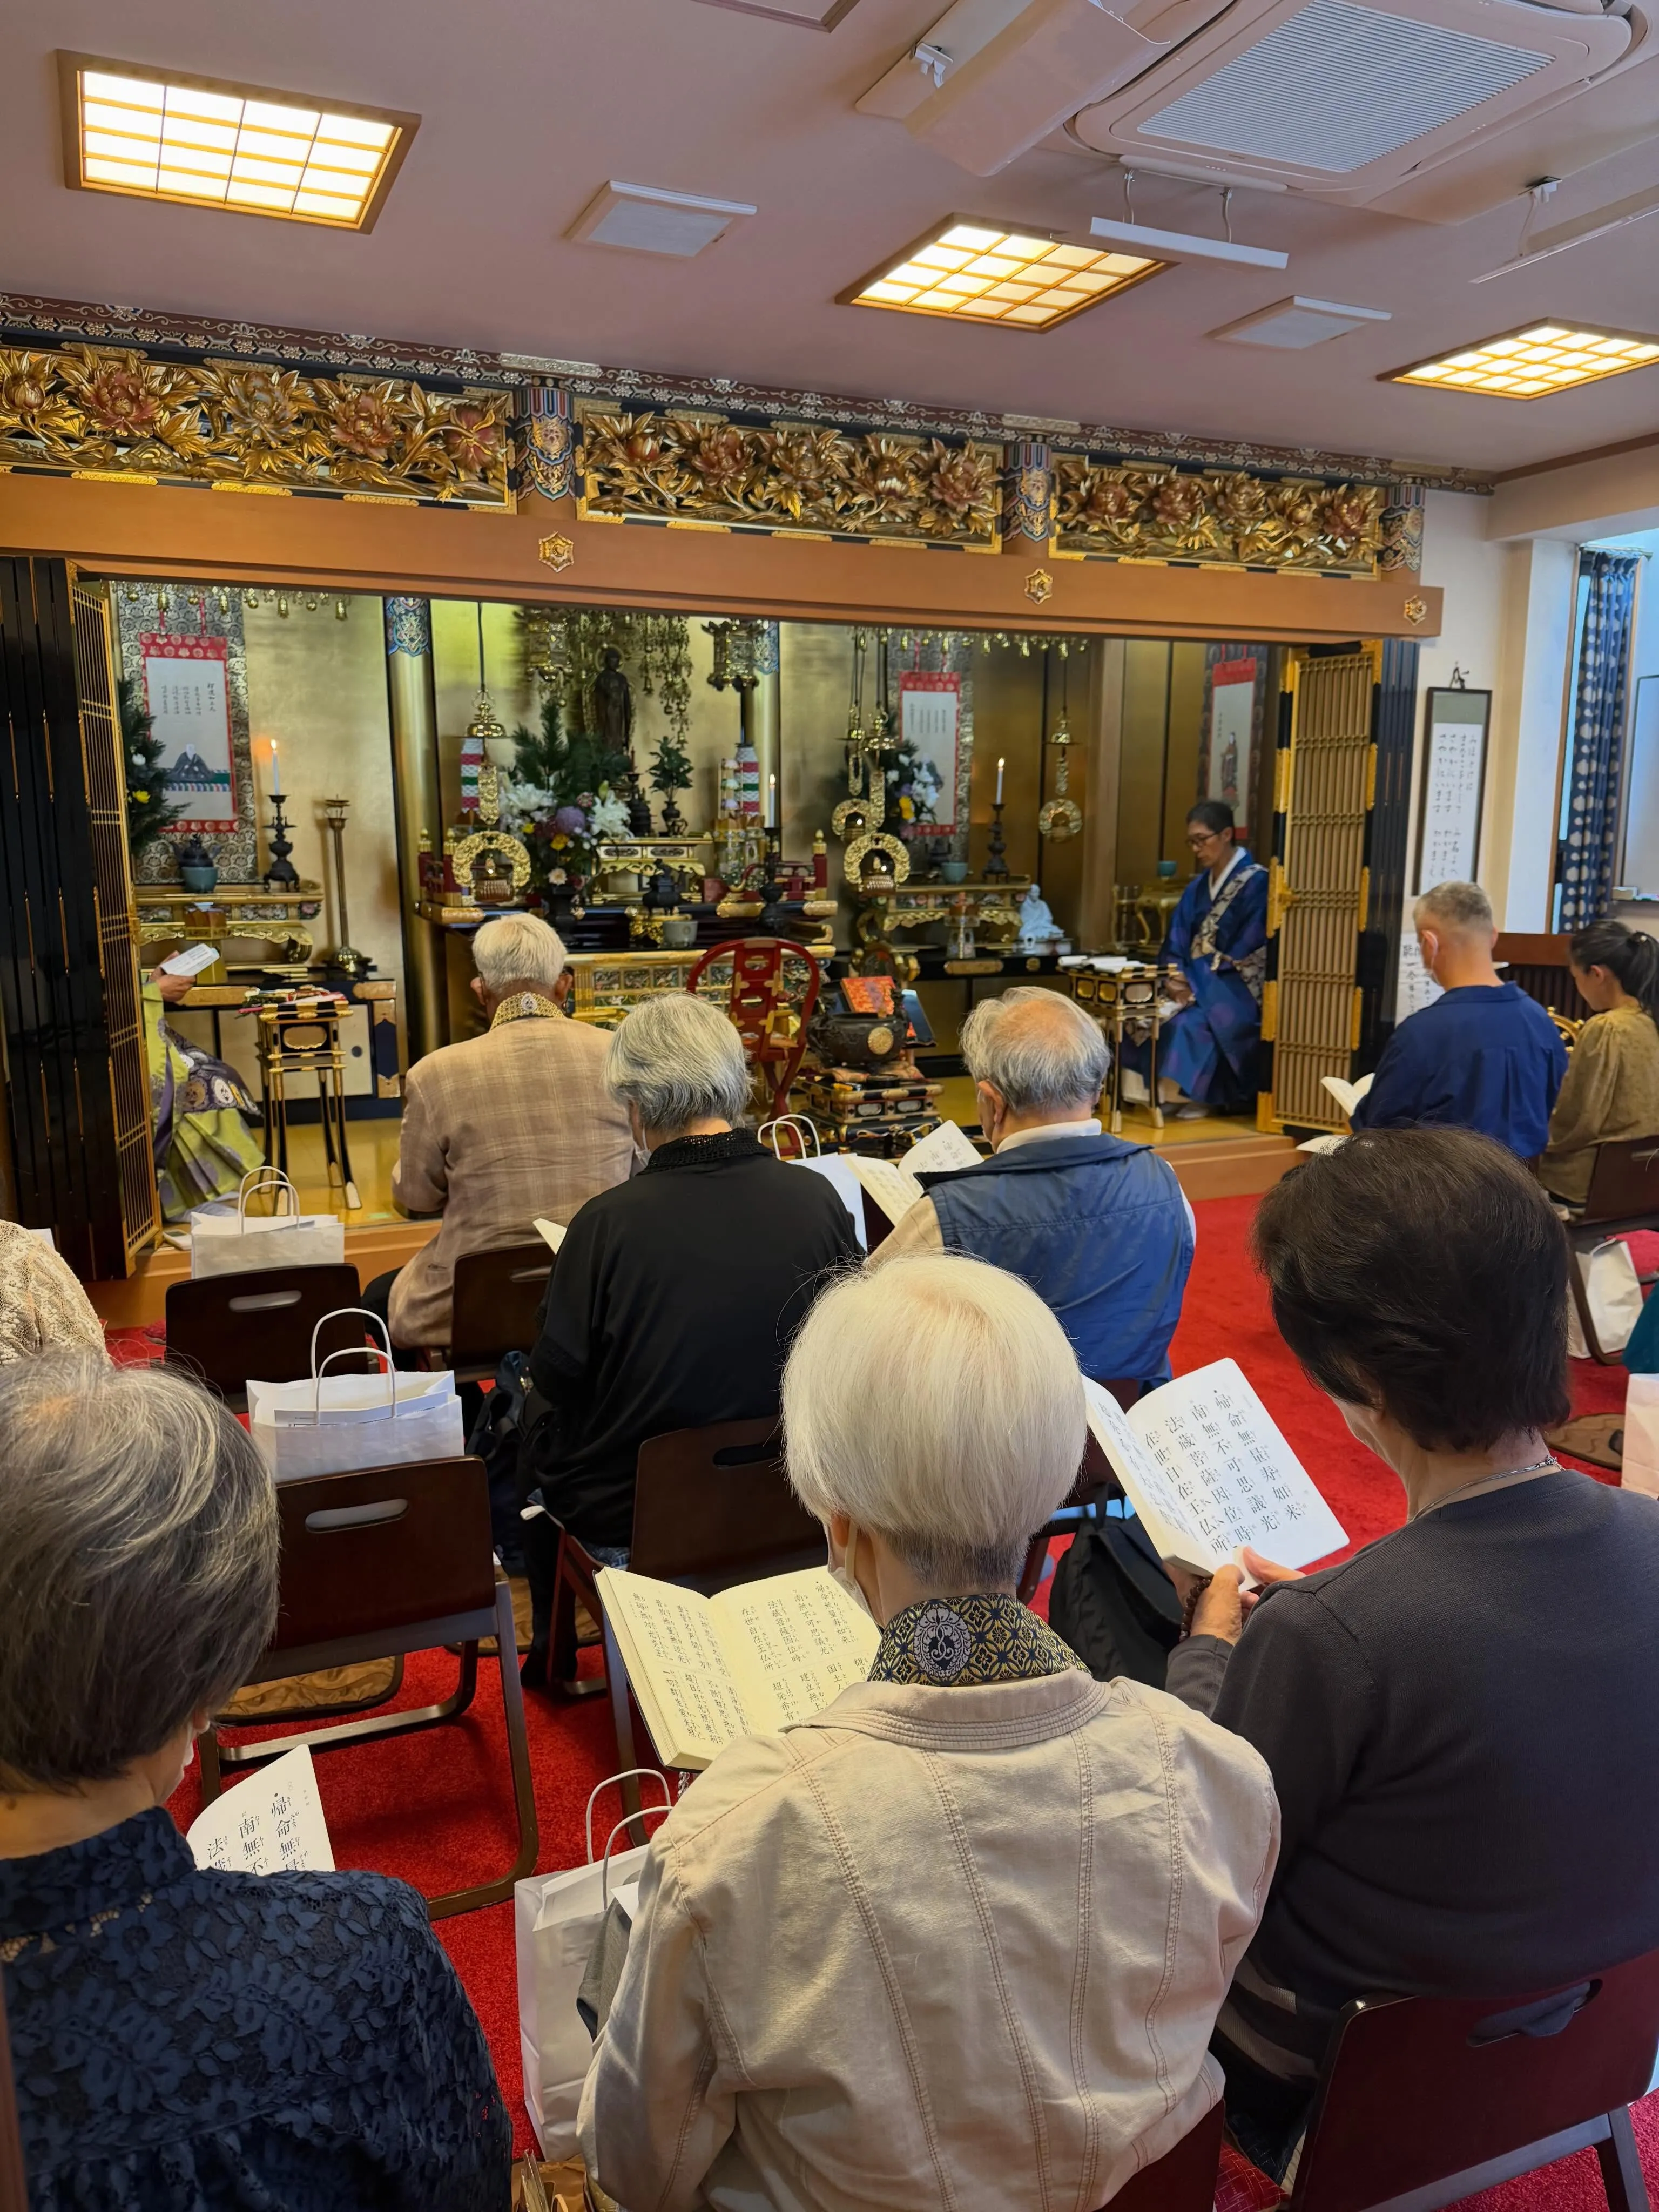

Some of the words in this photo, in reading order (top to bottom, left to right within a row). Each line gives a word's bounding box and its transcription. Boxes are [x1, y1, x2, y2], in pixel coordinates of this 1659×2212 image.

[1145, 1433, 1228, 1555] 在世自在王仏所
[1192, 1405, 1278, 1533] 南無不可思議光
[1215, 1393, 1301, 1520] 帰命無量寿如来
[742, 1608, 774, 1671] 在世自在王仏所
[795, 1594, 830, 1655] 南無不可思議光
